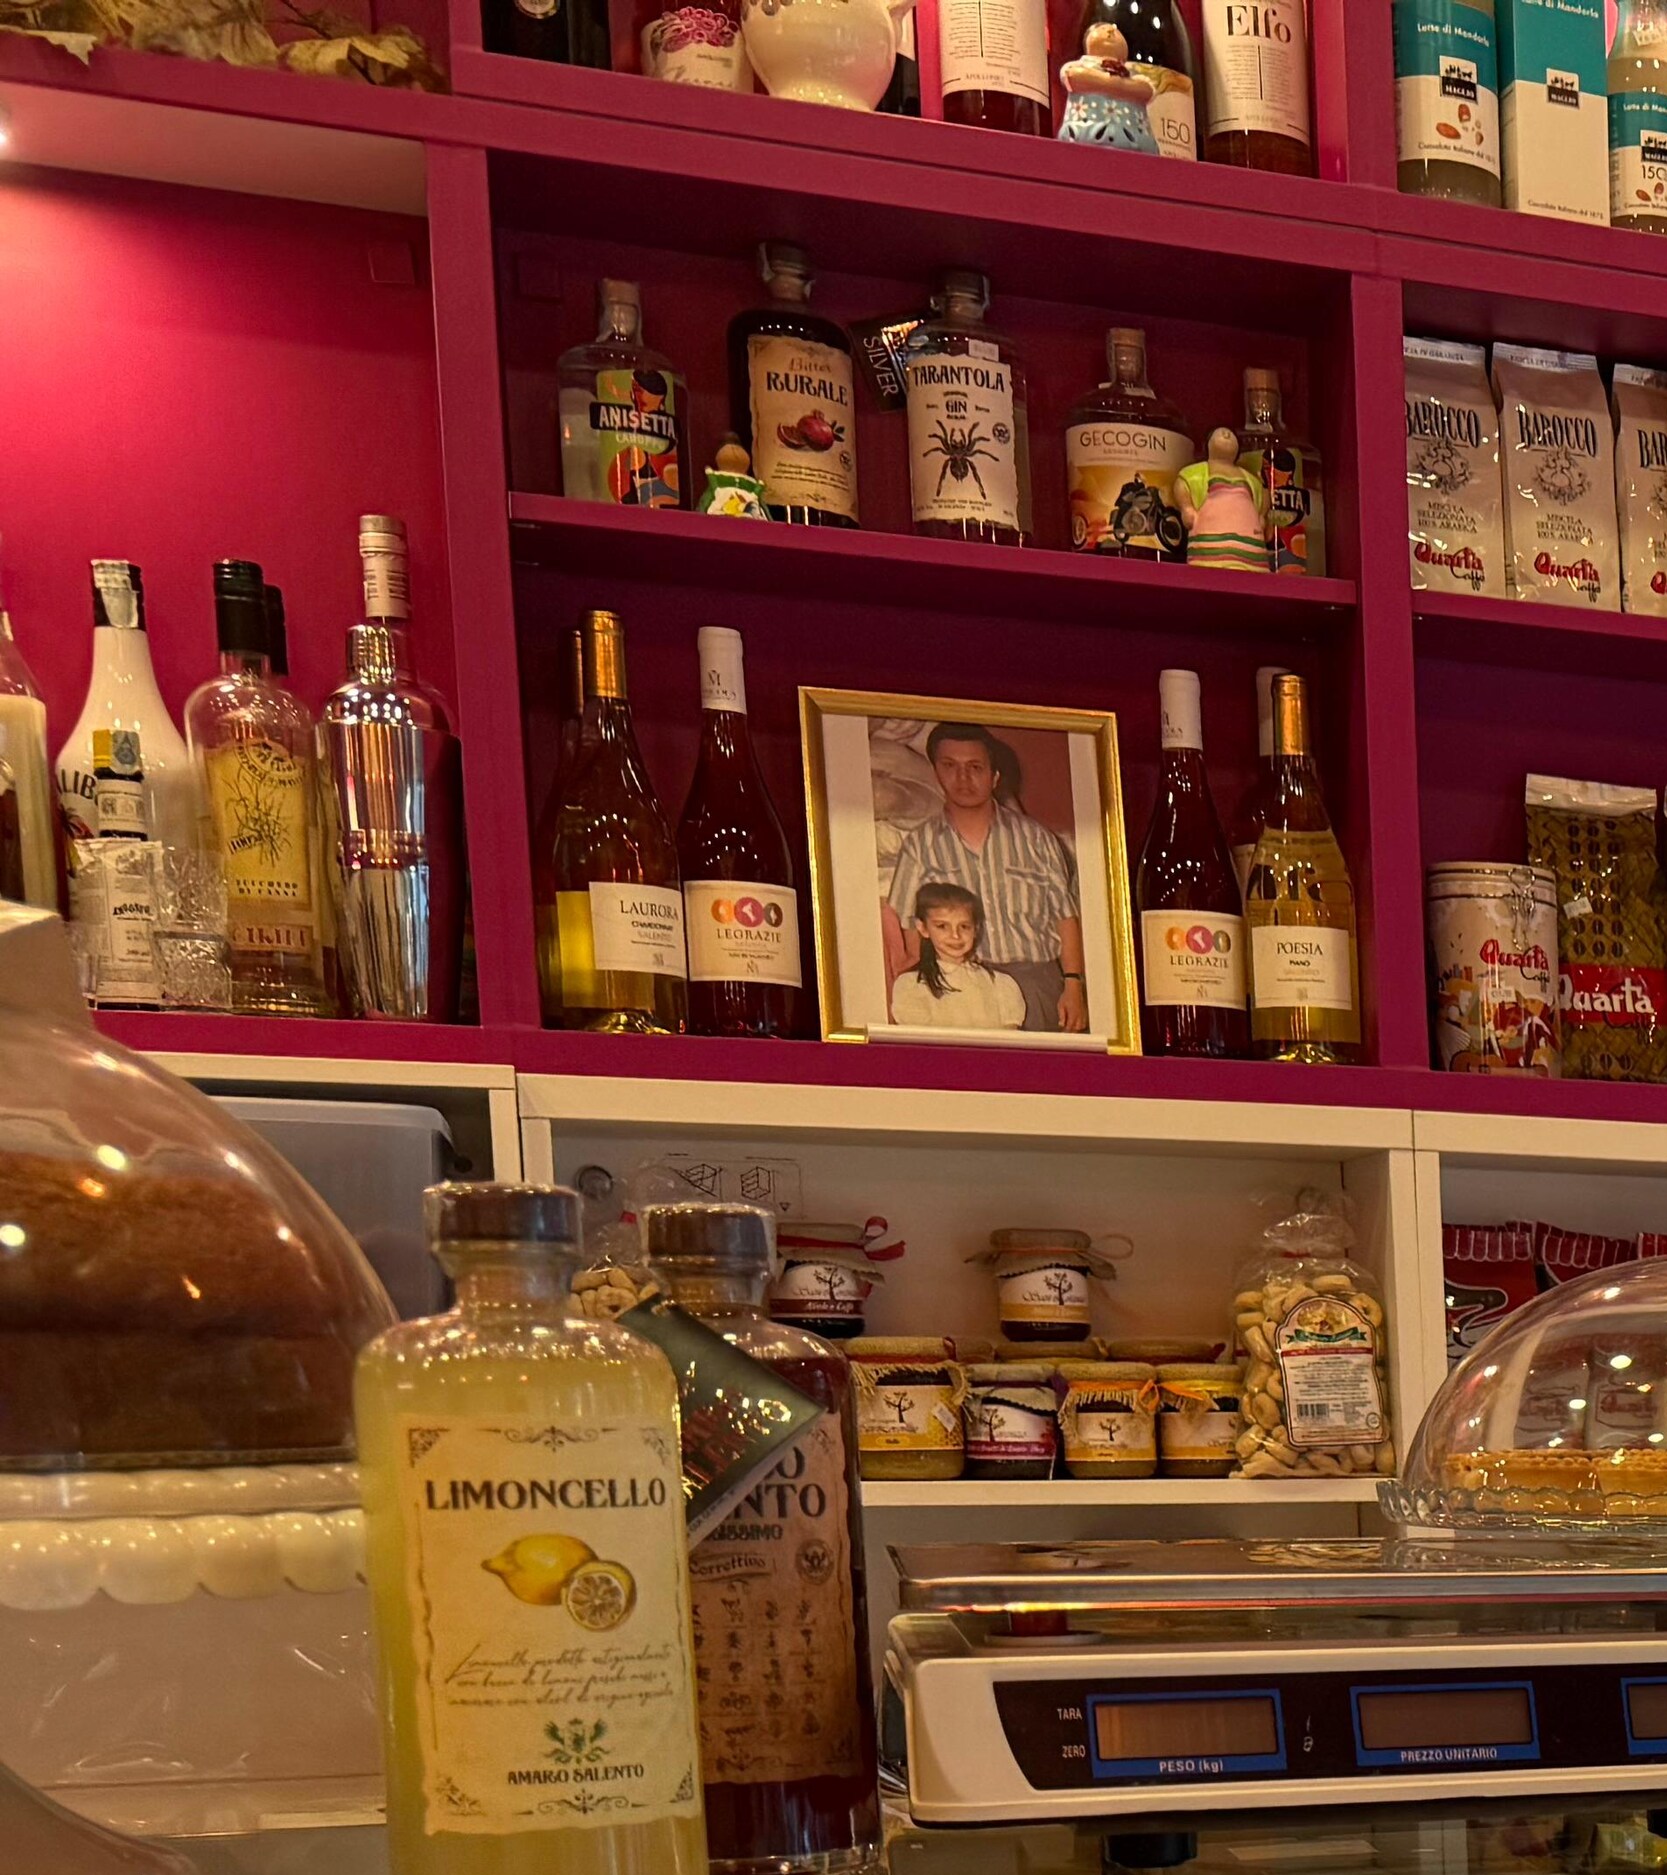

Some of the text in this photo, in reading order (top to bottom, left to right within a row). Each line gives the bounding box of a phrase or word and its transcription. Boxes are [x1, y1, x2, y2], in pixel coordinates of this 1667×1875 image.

[1226, 4, 1292, 44] Elfo
[1160, 117, 1191, 145] 150
[863, 335, 899, 397] SILVER
[913, 365, 1005, 393] TARANTOLA
[766, 371, 849, 407] RURALE
[945, 400, 968, 413] GIN
[599, 405, 676, 439] ANISETTA
[1518, 410, 1597, 458] BAROCCO
[1080, 430, 1167, 452] GECOGIN
[620, 900, 679, 921] LAURORA
[1277, 941, 1324, 956] POESIA
[1480, 939, 1549, 970] Quarta
[1558, 973, 1654, 1014] Quarta
[426, 1478, 666, 1511] LIMONCELLO
[1057, 1707, 1082, 1721] TARA
[1062, 1745, 1086, 1758] ZERO
[1400, 1747, 1498, 1762] PREZZO UNITARIO
[508, 1764, 645, 1785] AMARO SALENTO
[1159, 1759, 1224, 1773] PESO (kg)
